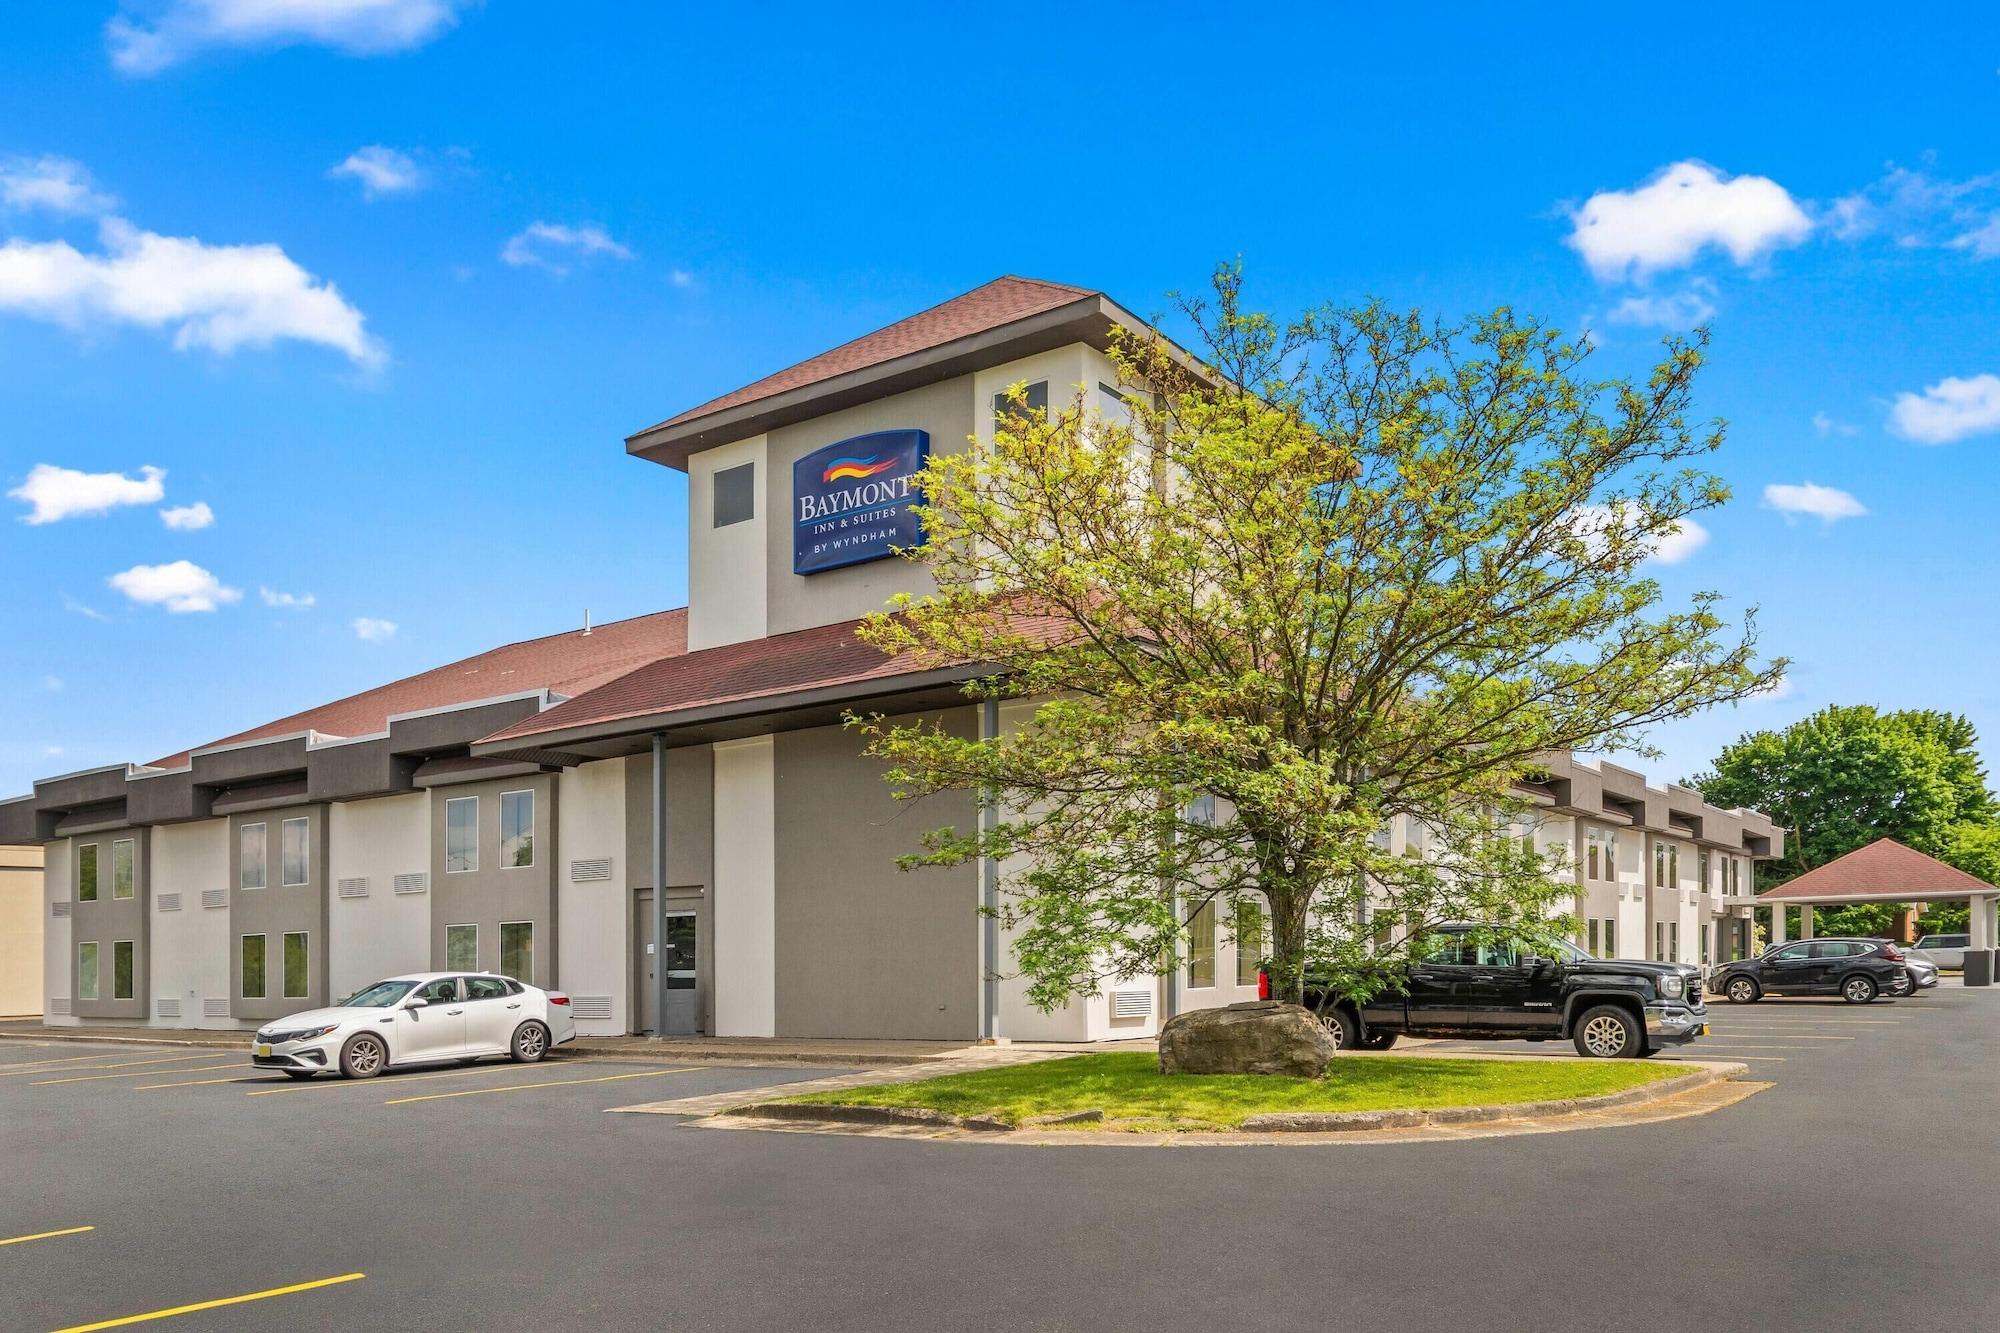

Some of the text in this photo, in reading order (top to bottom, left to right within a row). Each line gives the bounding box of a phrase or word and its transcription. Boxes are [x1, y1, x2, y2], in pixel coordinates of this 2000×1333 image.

[799, 474, 913, 522] BAYMONT
[814, 507, 896, 534] INN & SUITES
[814, 528, 896, 554] BY WYNDHAM
